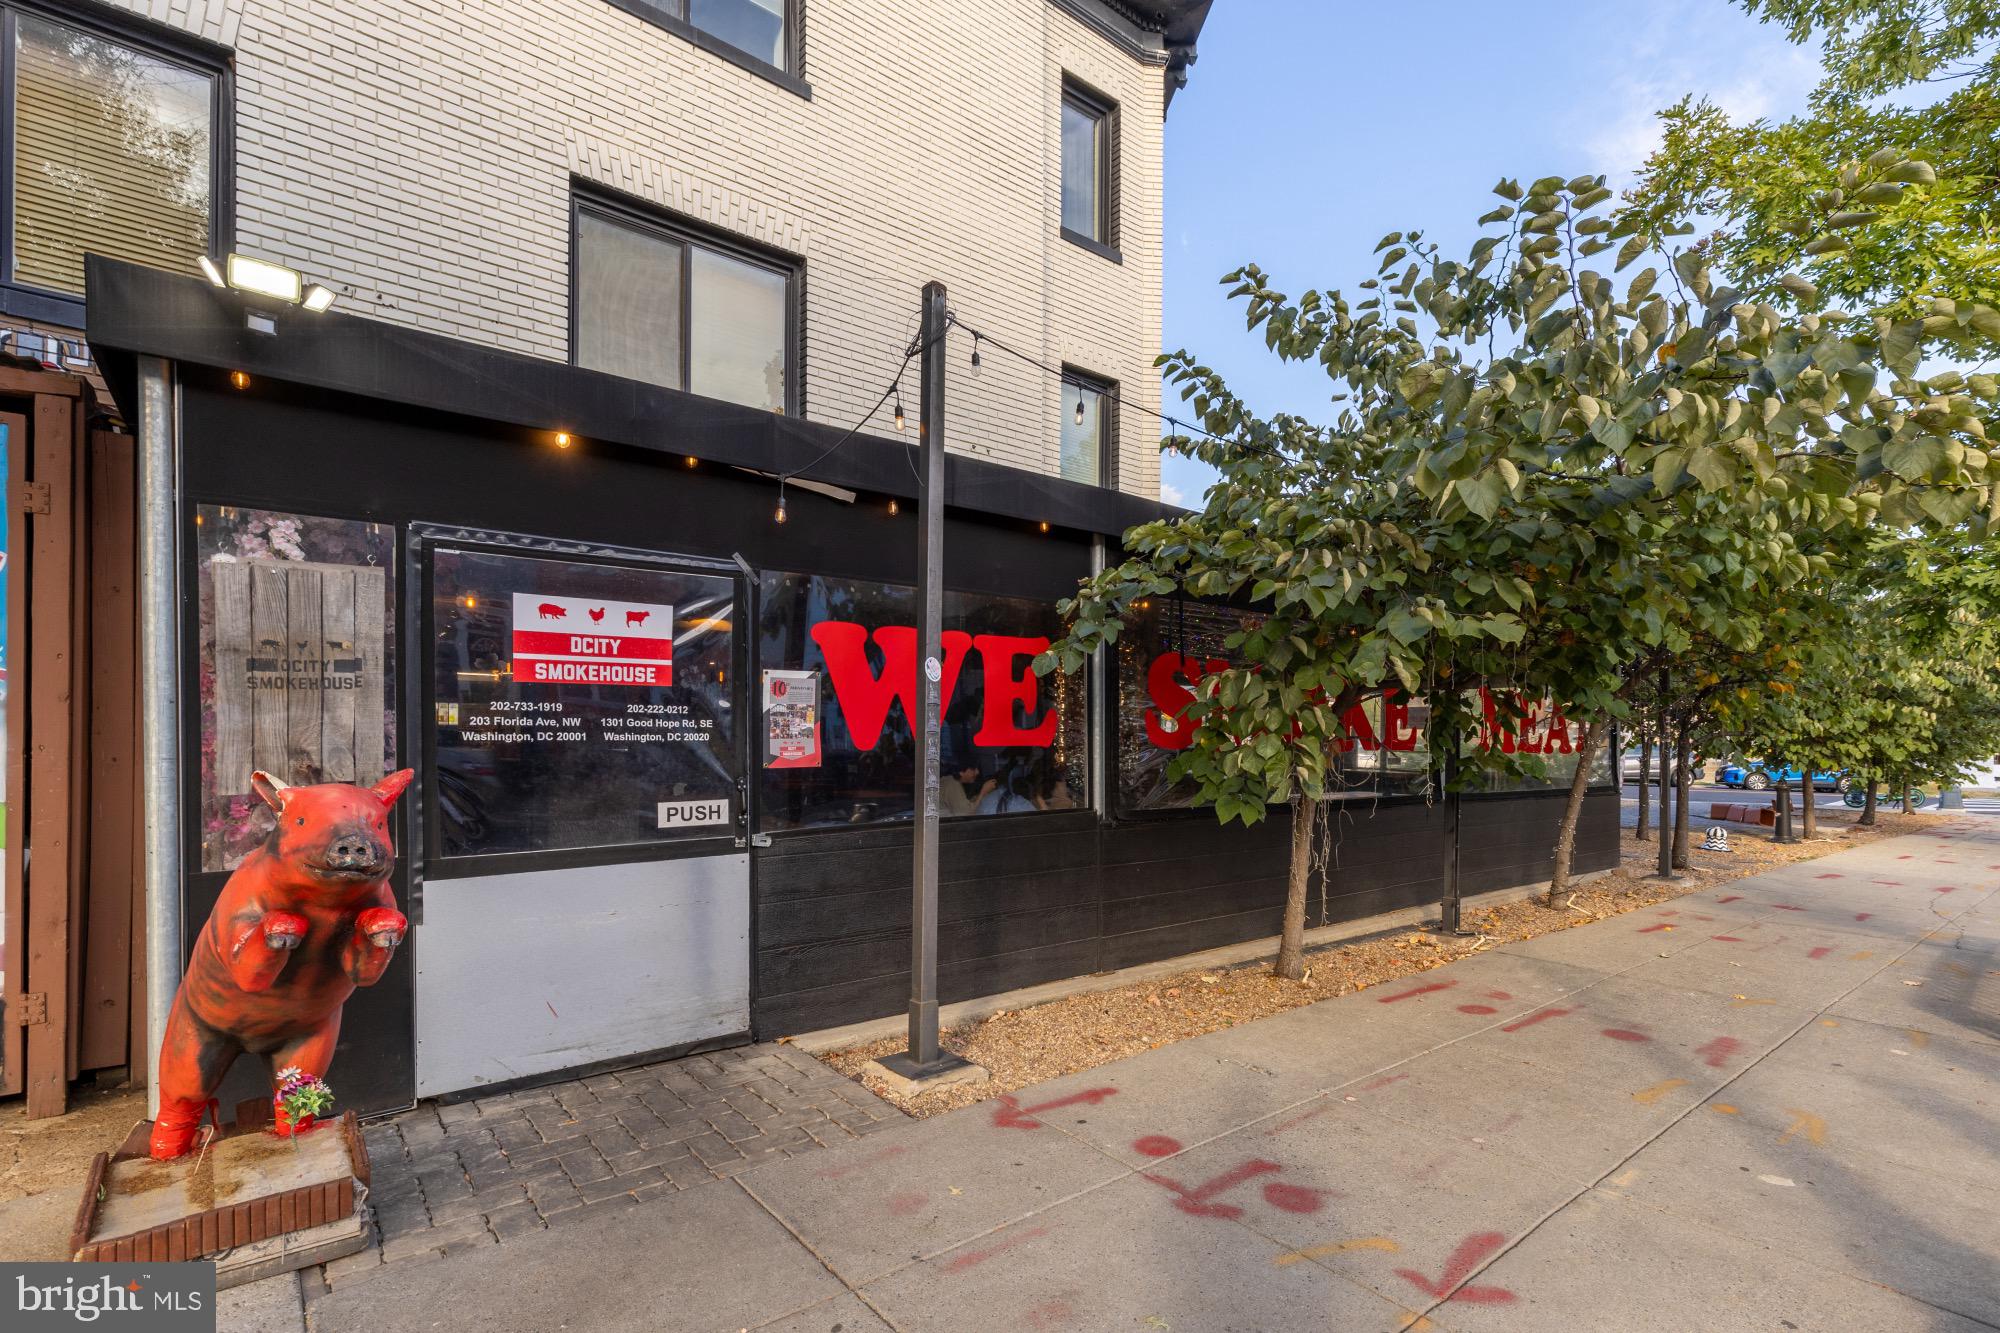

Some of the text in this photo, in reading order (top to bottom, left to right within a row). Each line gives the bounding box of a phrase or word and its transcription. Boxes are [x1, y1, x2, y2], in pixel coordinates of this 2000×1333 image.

[571, 636, 621, 655] DCITY
[535, 662, 656, 683] SMOKEHOUSE
[247, 675, 363, 690] SMOKEHOUSE
[810, 620, 1057, 751] WE
[490, 701, 563, 712] 202-733-1919
[627, 704, 688, 714] 202-222-0212
[469, 716, 581, 728] 203 Florida Ave, NW
[601, 718, 713, 729] 1301 Good Hope Rd, SE
[462, 731, 586, 743] Washington, DC 20001
[604, 732, 709, 743] Washington, DC 20020
[666, 805, 721, 822] PUSH
